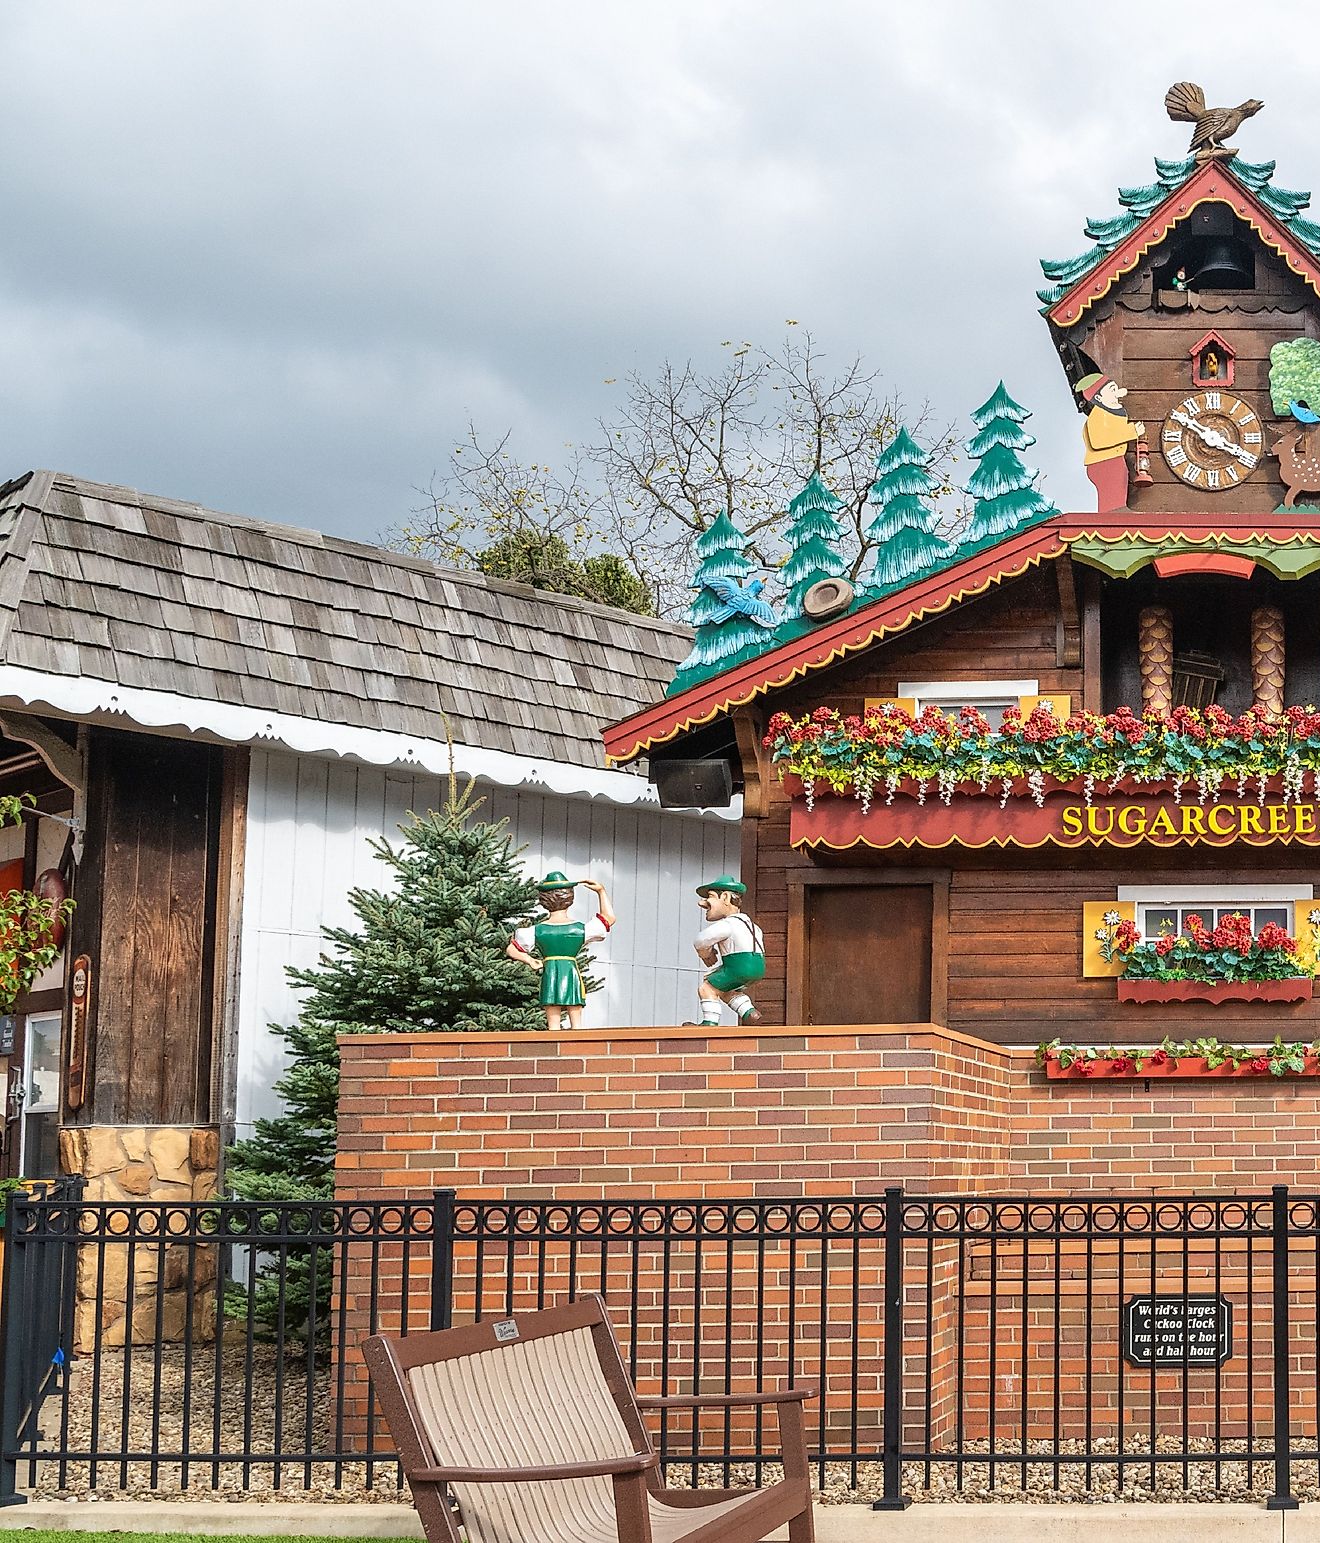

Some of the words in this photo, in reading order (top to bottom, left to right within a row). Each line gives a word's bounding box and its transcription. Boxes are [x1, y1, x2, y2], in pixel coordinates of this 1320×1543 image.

[1143, 1318, 1183, 1329] Cckoo
[1187, 1318, 1215, 1329] Clock
[1161, 1334, 1176, 1343] on
[1178, 1332, 1197, 1342] te
[1142, 1345, 1164, 1356] ad
[1166, 1345, 1188, 1356] hal
[1189, 1345, 1217, 1356] hour
